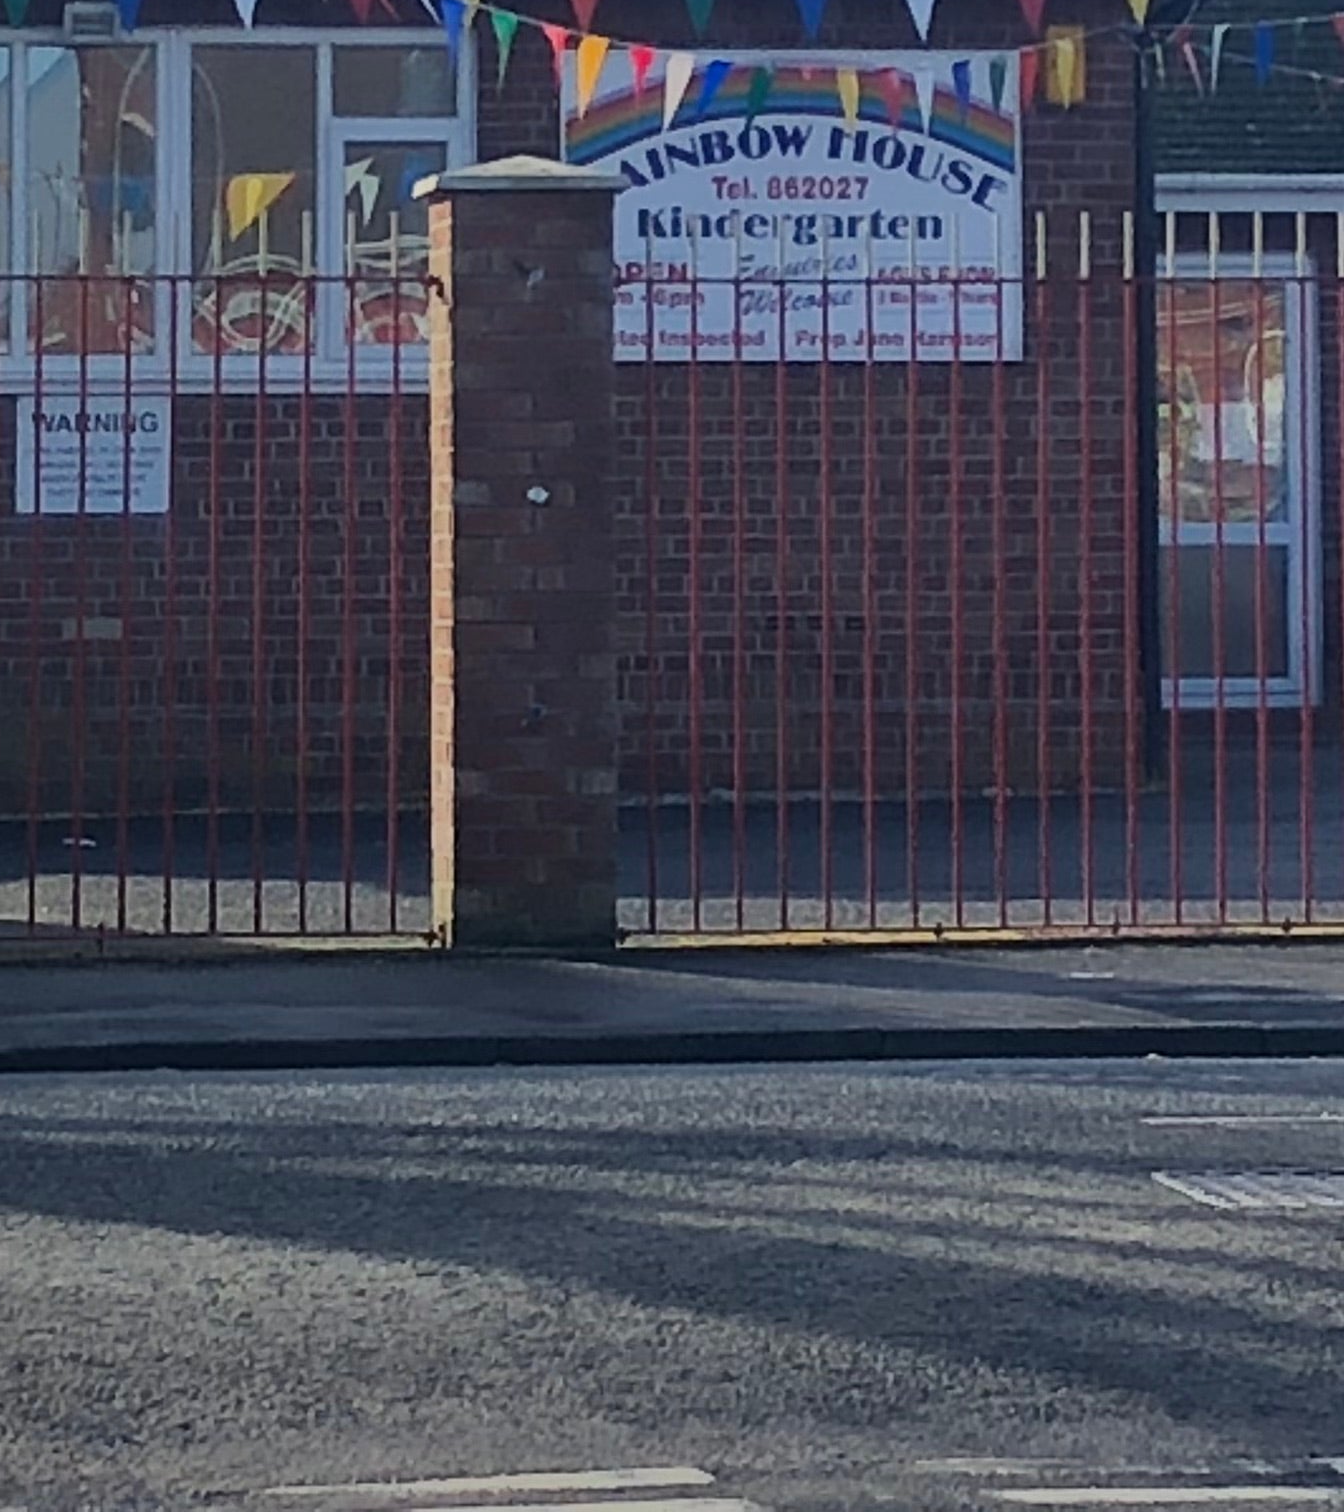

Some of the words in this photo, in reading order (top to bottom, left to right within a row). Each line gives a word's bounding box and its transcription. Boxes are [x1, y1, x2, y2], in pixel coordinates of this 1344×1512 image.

[621, 124, 814, 192] AINBOW
[827, 126, 1009, 212] HOUSE
[712, 175, 758, 201] Tel.
[767, 175, 870, 201] 862027
[637, 206, 944, 246] Kindergarten
[32, 411, 160, 433] WARNING
